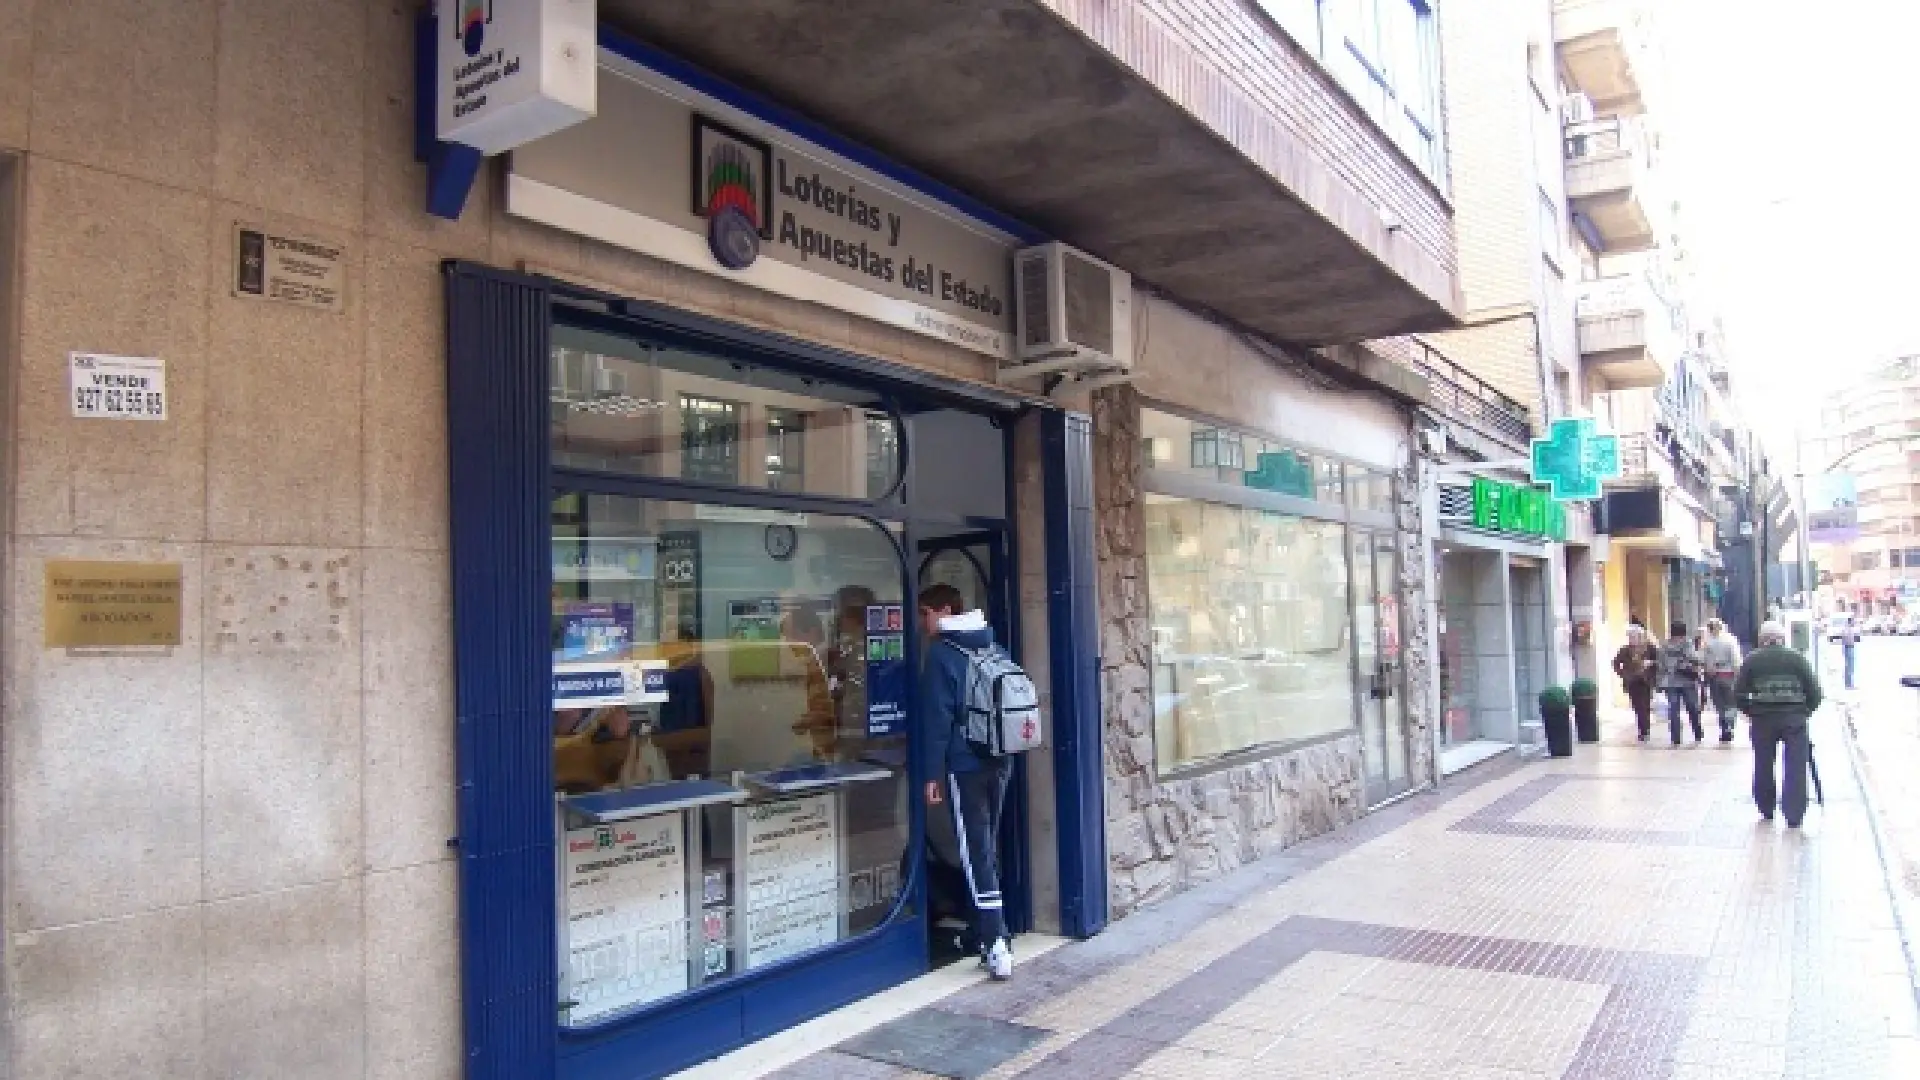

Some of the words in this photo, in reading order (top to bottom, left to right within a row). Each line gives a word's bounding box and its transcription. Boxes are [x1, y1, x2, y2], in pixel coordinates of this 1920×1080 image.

[887, 213, 902, 247] y
[778, 210, 895, 283] Apuestas
[901, 256, 934, 295] del
[939, 269, 1002, 316] Estado
[92, 373, 149, 389] VENDE
[77, 386, 102, 412] 927
[106, 388, 123, 412] 62
[126, 390, 143, 413] 55
[146, 392, 163, 415] 65
